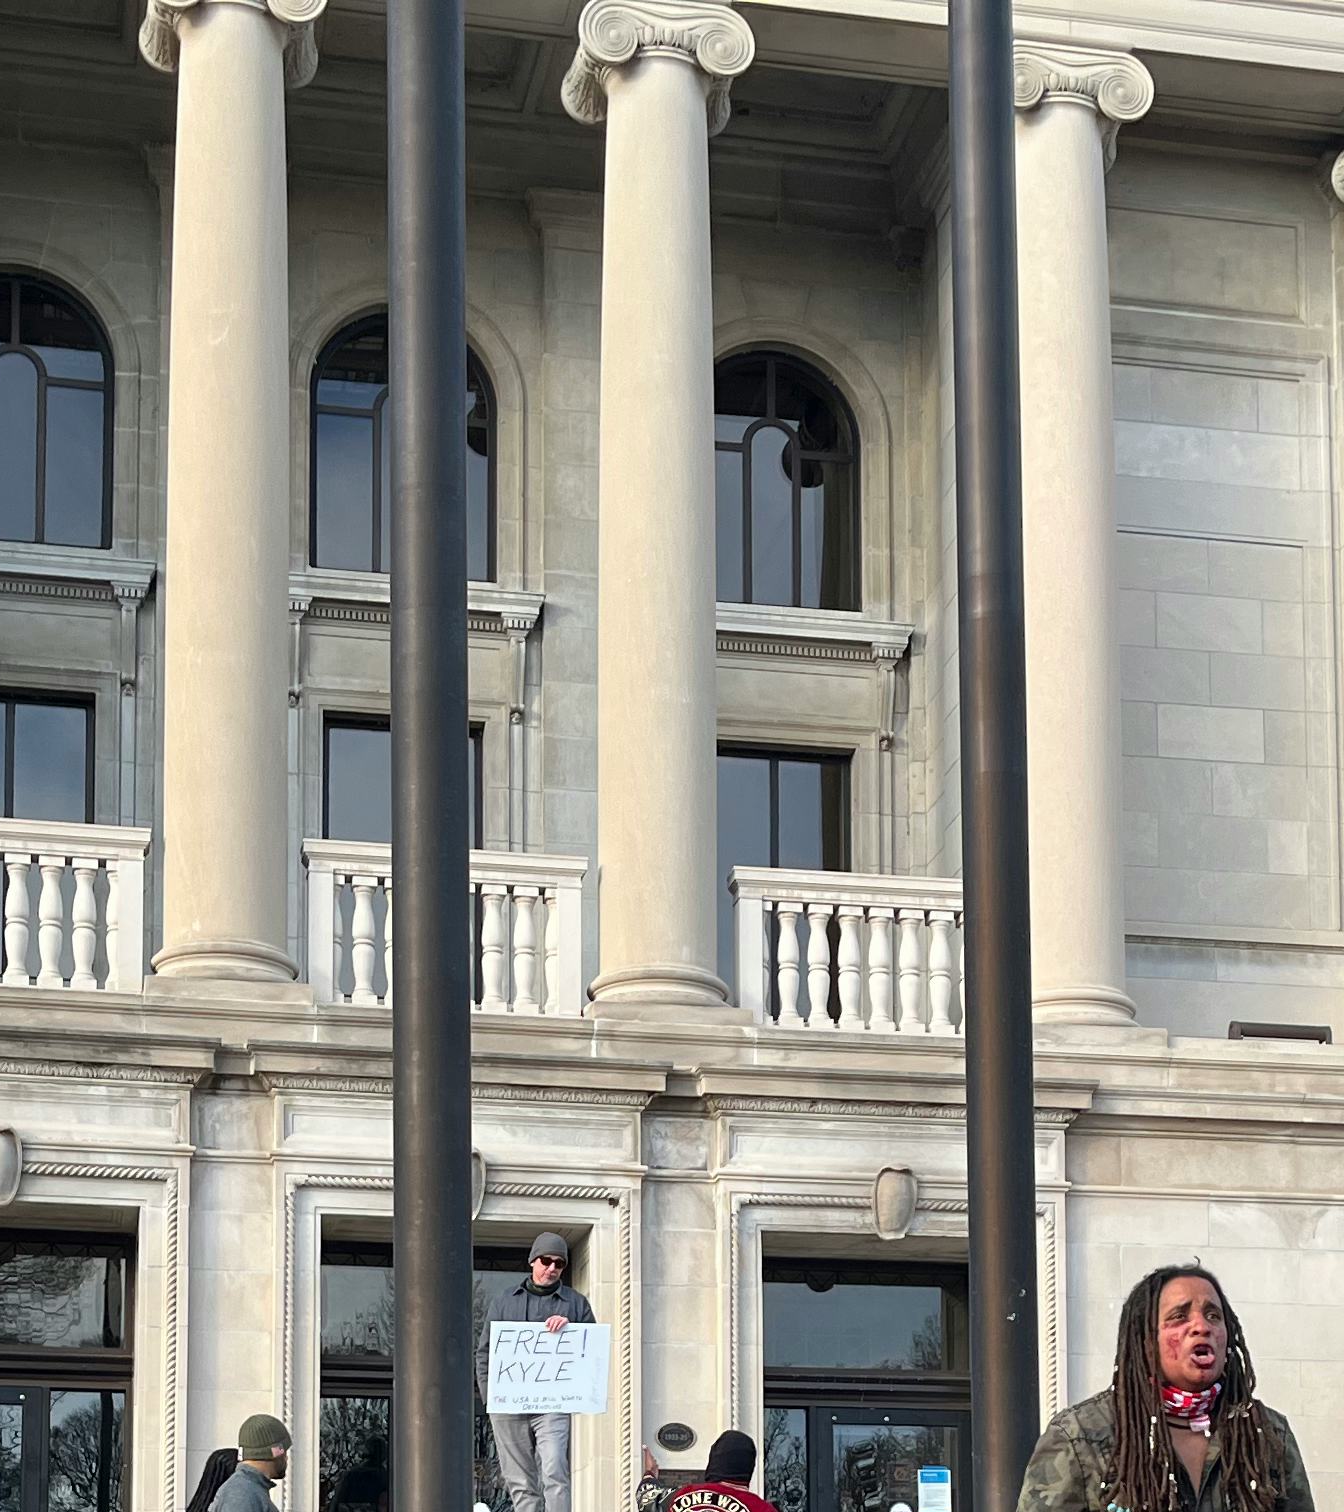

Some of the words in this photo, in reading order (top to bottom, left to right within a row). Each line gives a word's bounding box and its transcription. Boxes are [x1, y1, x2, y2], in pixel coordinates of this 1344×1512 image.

[494, 1328, 587, 1358] FREE!
[497, 1360, 574, 1383] KYLE
[494, 1395, 507, 1403] THE
[512, 1395, 529, 1404] USA
[672, 1492, 712, 1512] LONE
